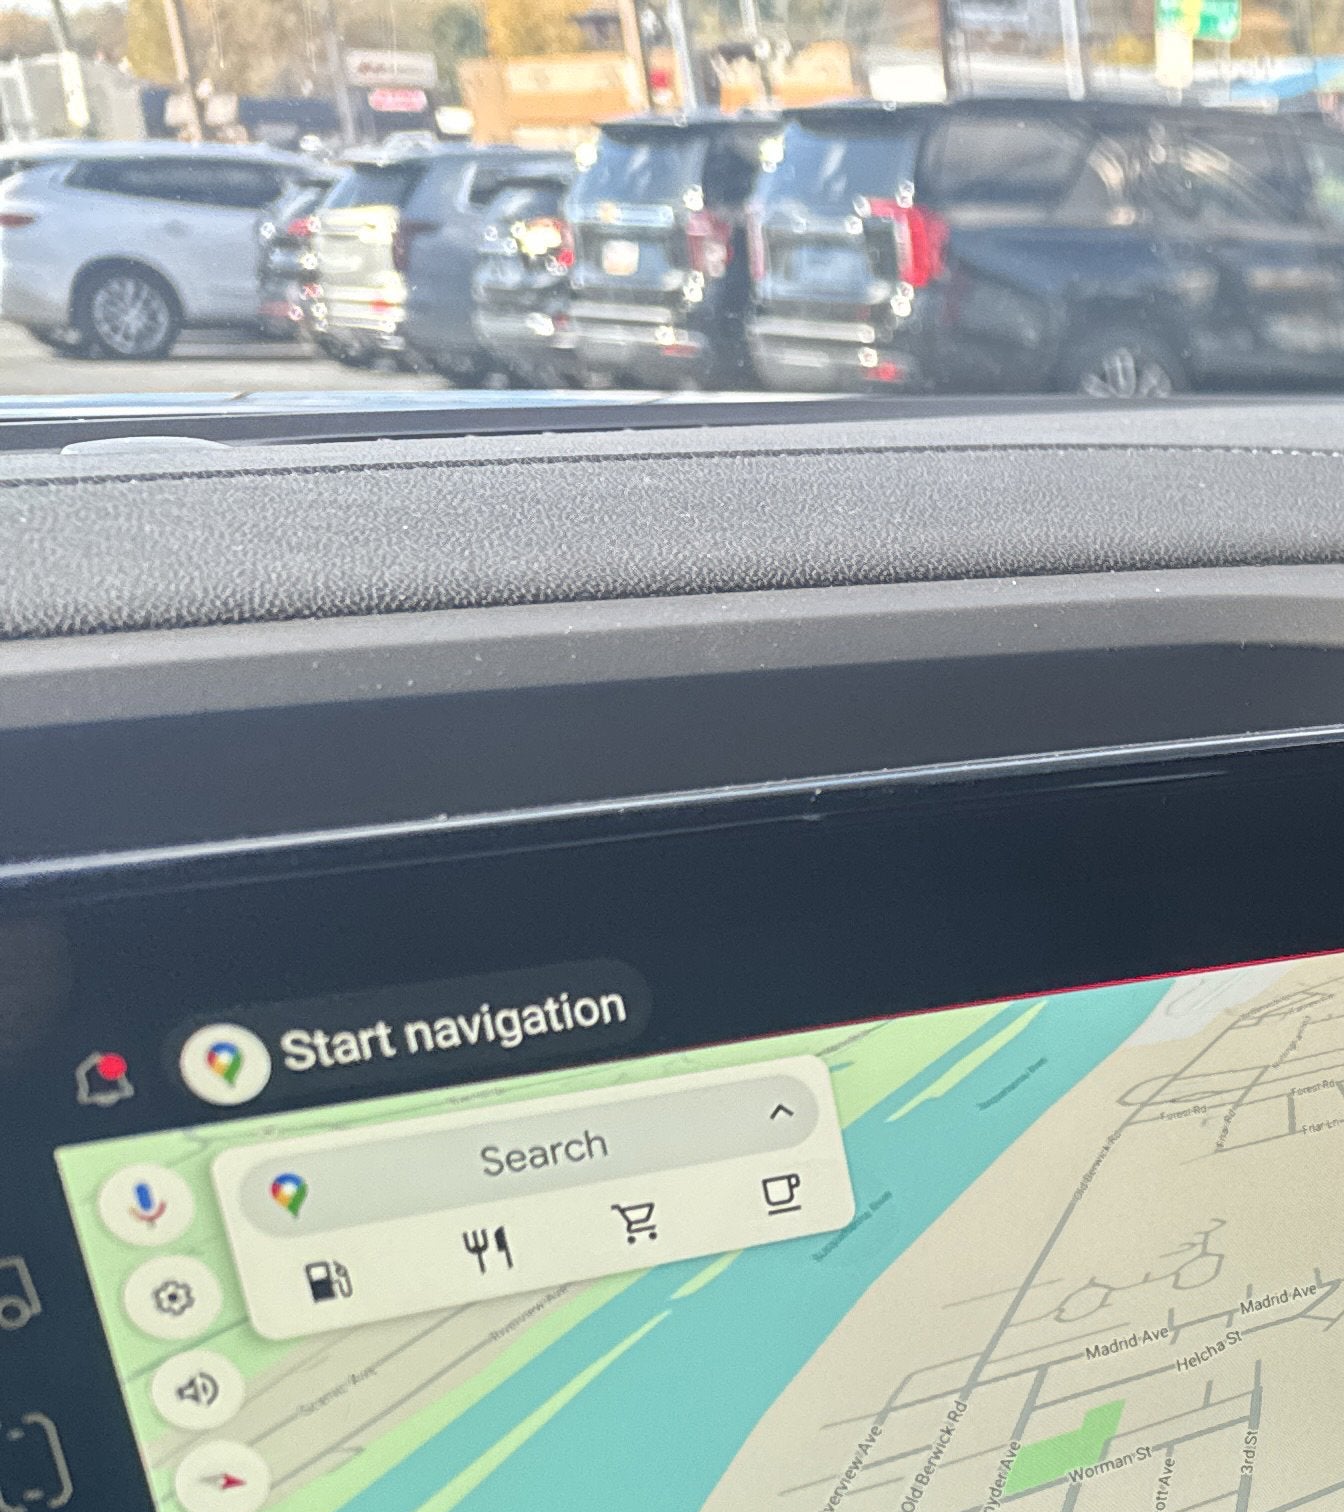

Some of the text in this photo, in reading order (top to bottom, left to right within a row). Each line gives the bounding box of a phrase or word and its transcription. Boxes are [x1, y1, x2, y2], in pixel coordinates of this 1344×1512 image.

[280, 991, 627, 1072] Start navigation
[480, 1130, 609, 1177] Search
[1240, 1283, 1317, 1315] Madrid Ave
[1085, 1325, 1169, 1360] Madrid Ave
[1176, 1330, 1243, 1372] Helcha St
[857, 1425, 883, 1457] Ave
[914, 1425, 955, 1487] Berwick
[946, 1400, 968, 1424] Rd
[999, 1440, 1021, 1472] Ave
[1240, 1430, 1259, 1474] 3rd St
[1068, 1446, 1153, 1483] Worman St
[1158, 1457, 1176, 1487] Ave
